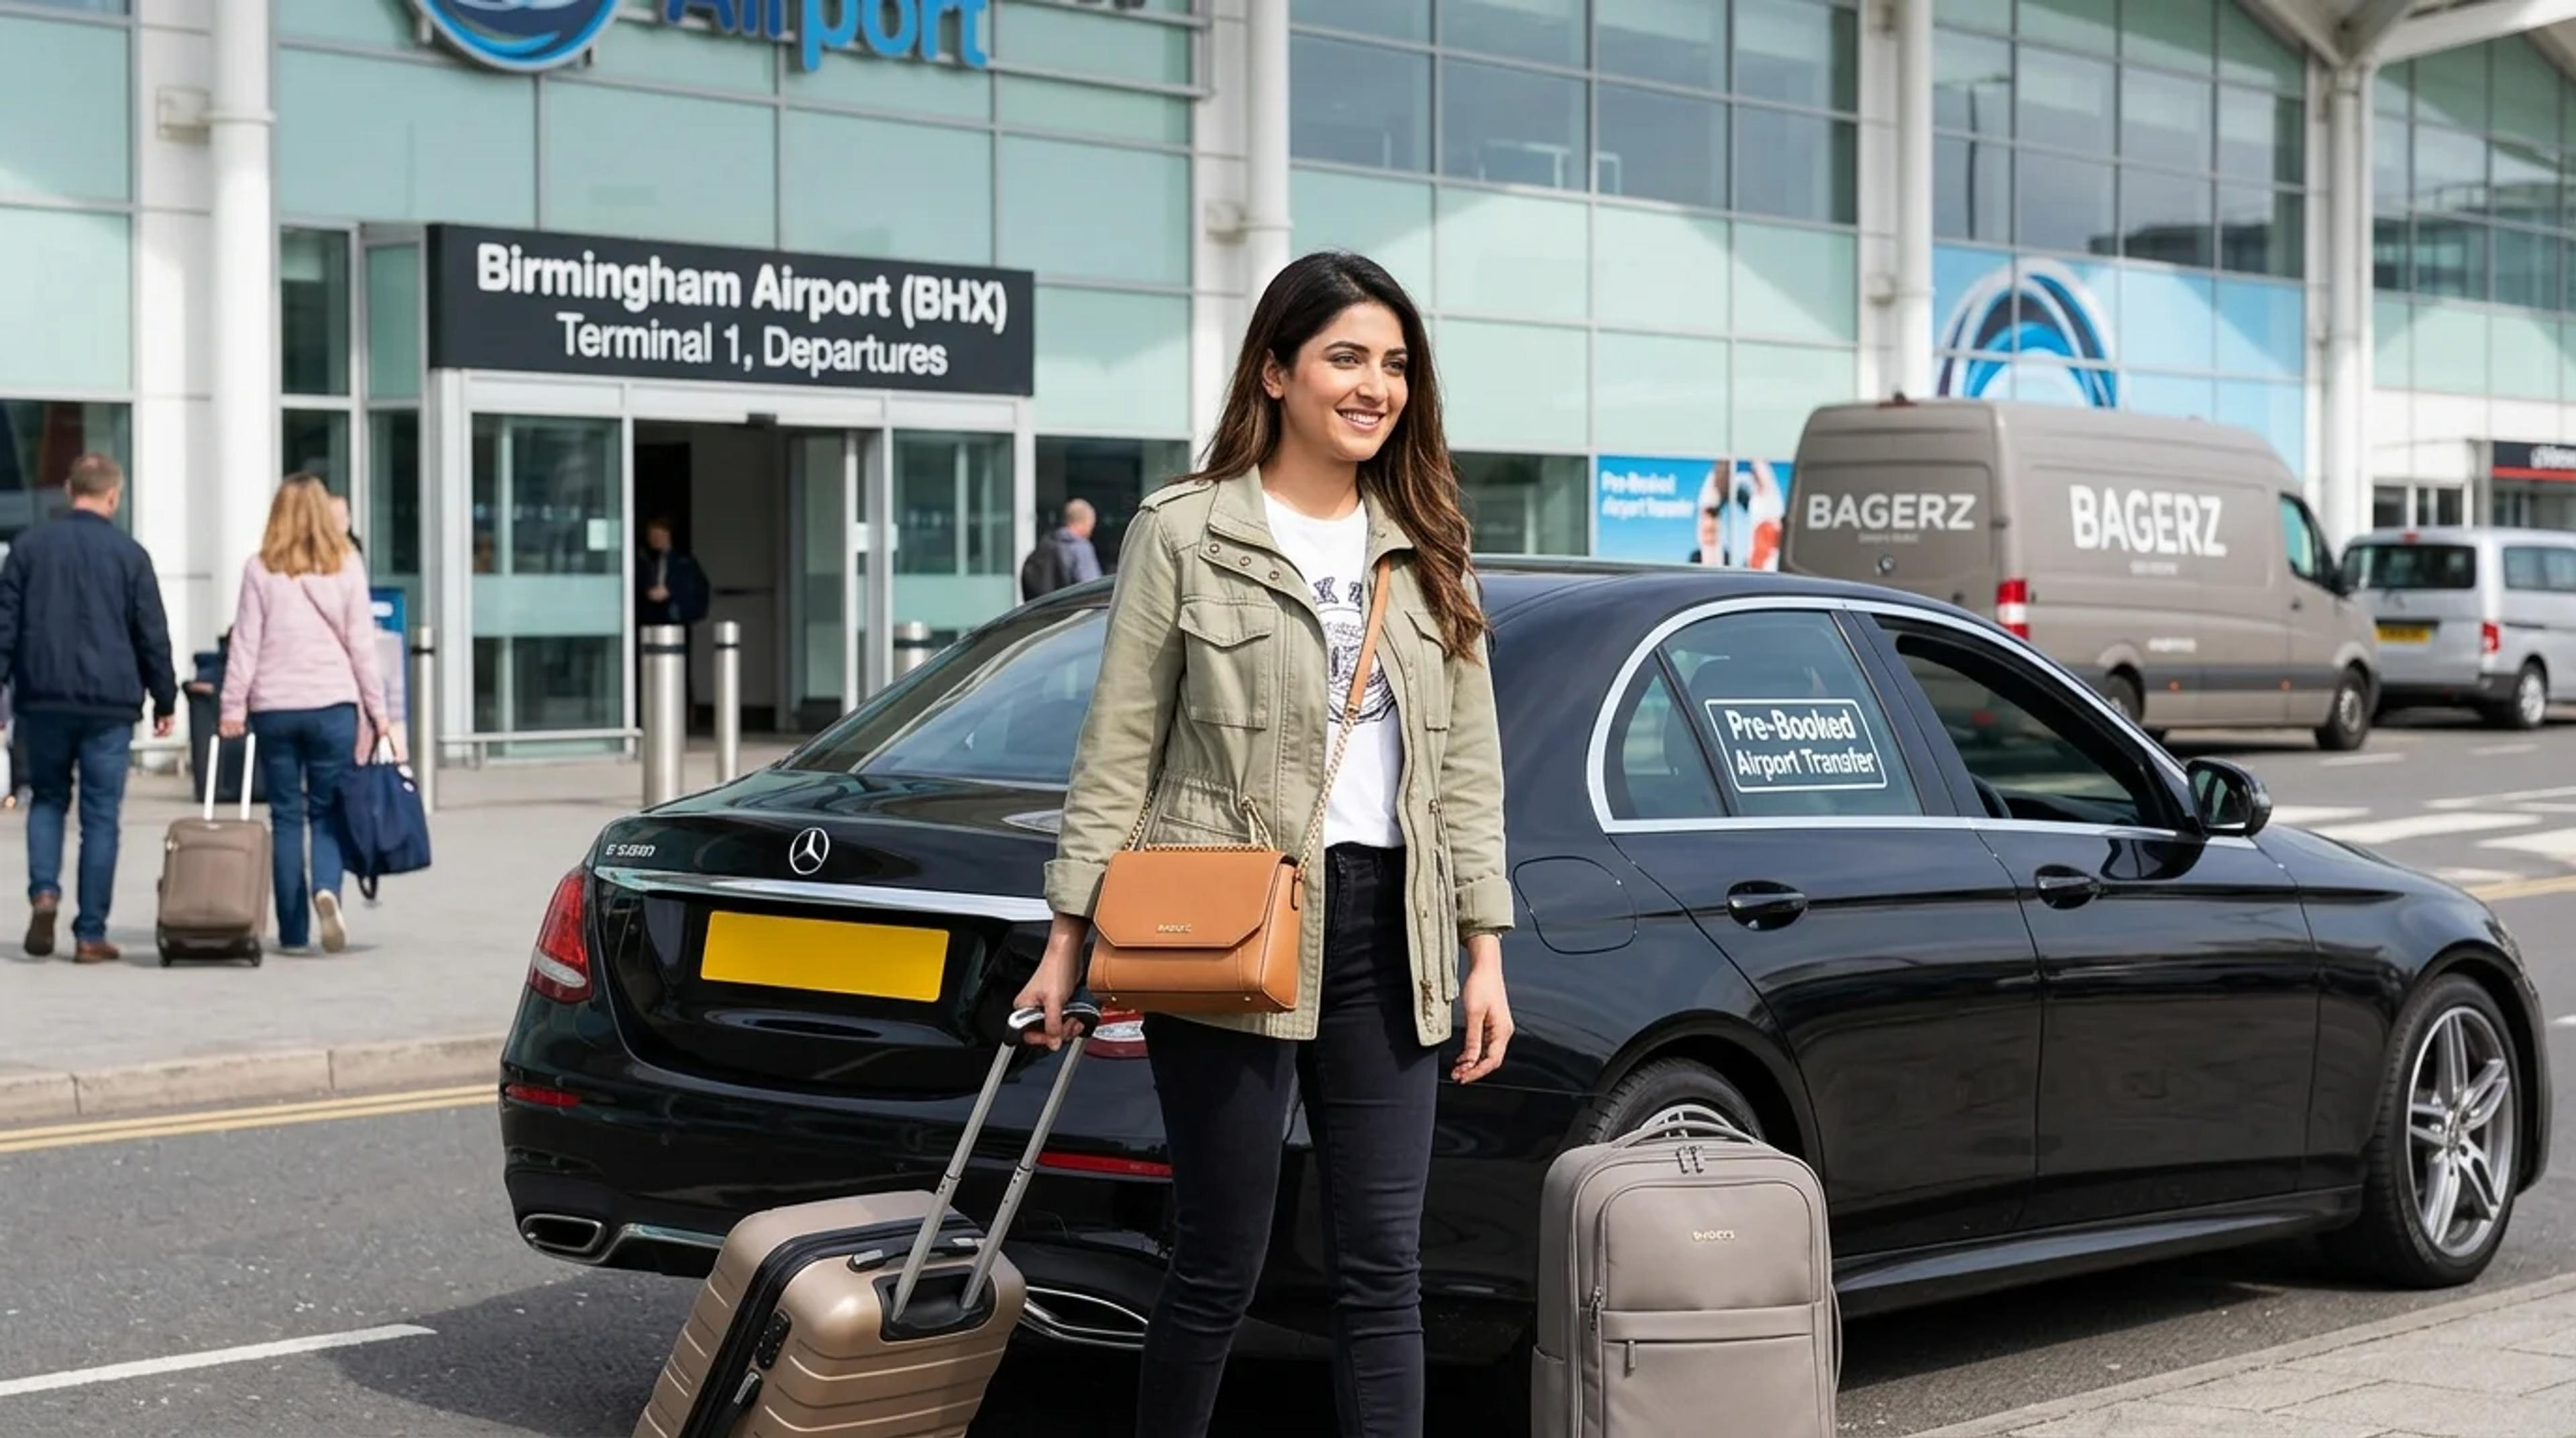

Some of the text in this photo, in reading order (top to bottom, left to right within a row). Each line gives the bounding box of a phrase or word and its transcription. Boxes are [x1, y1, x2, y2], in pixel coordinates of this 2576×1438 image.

[477, 242, 1007, 334] Birmingham Airport (BHX)
[555, 311, 949, 378] Terminal 1, Departures
[1807, 493, 1977, 530] BAGERZ
[2069, 484, 2227, 558] BAGERZ
[1735, 748, 1802, 782] Airport
